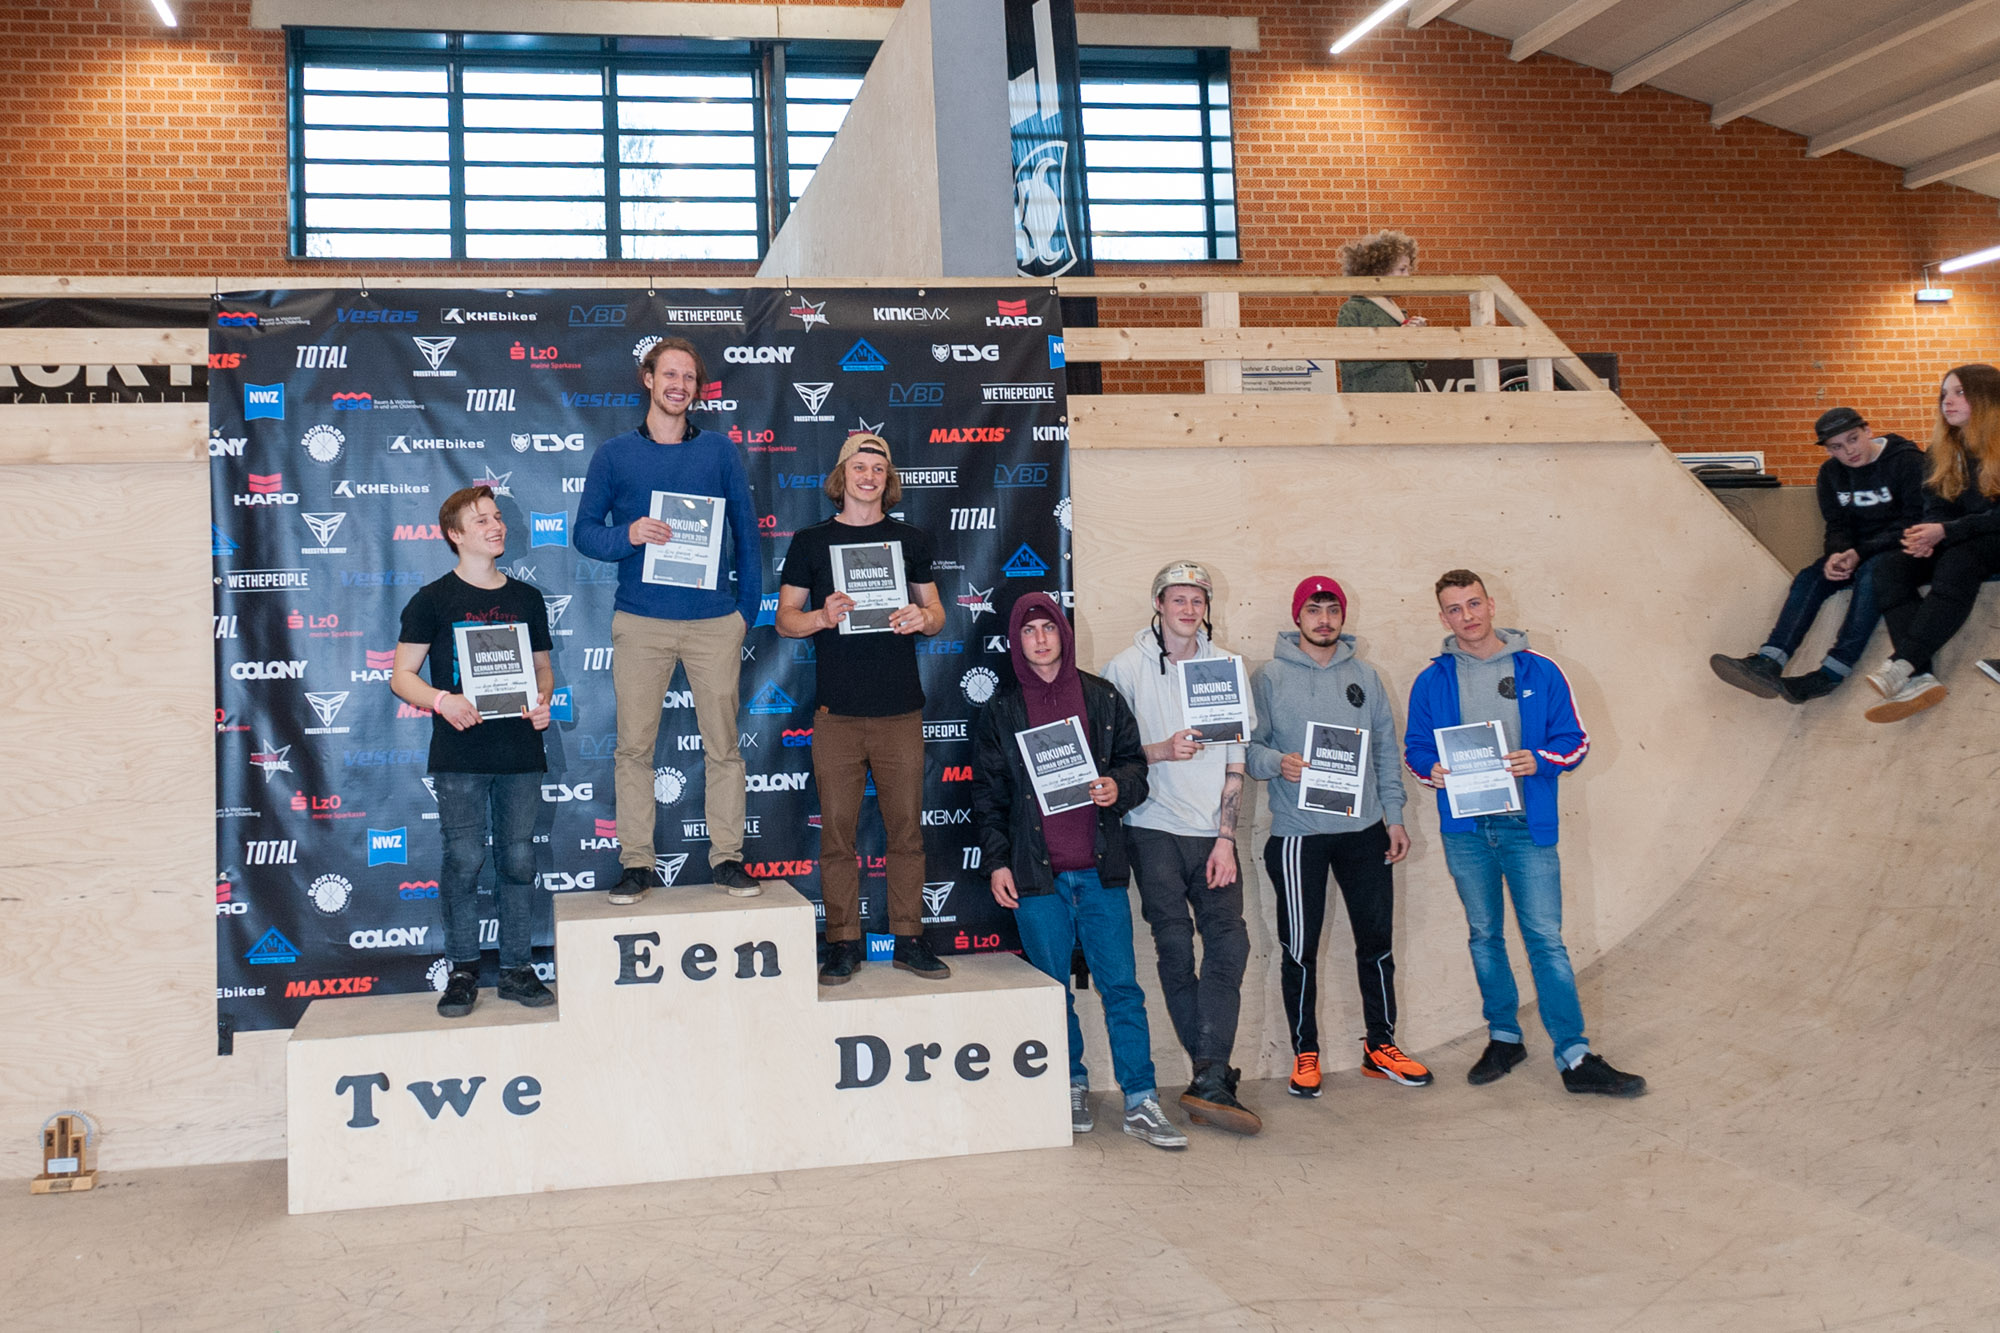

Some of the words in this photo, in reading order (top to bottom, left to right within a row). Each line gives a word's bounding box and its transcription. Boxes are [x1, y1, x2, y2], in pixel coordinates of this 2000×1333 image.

[336, 308, 419, 323] Vestas
[466, 312, 535, 321] KHEbikes
[667, 309, 743, 322] WETHEPEOPLE
[873, 307, 950, 320] KINKBMX
[986, 316, 1042, 327] HARO
[296, 346, 347, 368] TOTAL
[530, 346, 558, 360] LzO
[723, 346, 795, 364] COLONY
[208, 353, 241, 369] XIS
[249, 391, 279, 403] NWZ
[466, 389, 516, 411] TOTAL
[561, 392, 640, 407] Vestas
[982, 387, 1054, 400] WETHEPEOPLE
[332, 399, 372, 411] GSG
[301, 424, 345, 446] BACKYARD
[747, 429, 774, 443] LzO
[929, 427, 1005, 443] MAXXIS
[1033, 426, 1069, 441] KINK
[208, 438, 248, 456] ONY
[413, 439, 484, 449] KHEbikes
[895, 472, 957, 484] THEPEOPLE
[356, 484, 429, 493] KHEbikes
[234, 493, 299, 506] HARO
[535, 519, 563, 531] NWZ
[758, 514, 777, 528] zO
[950, 508, 996, 530] TOTAL
[393, 525, 442, 540] MAX
[228, 573, 308, 588] WETHEPEOPLE
[341, 571, 424, 586] Vestas
[849, 567, 889, 580] URKUNDE
[213, 615, 238, 638] TAL
[310, 615, 338, 627] LzO
[475, 650, 516, 663] URKUNDE
[583, 648, 613, 670] TOT
[230, 661, 308, 680] COLONY
[960, 667, 999, 689] BACKYARD
[1192, 681, 1233, 695] URKUNDE
[923, 724, 967, 737] EPEOPLE
[345, 751, 427, 766] Vestas
[1036, 743, 1076, 763] URKUNDE
[1316, 747, 1355, 763] URKUNDE
[1452, 746, 1495, 762] URKUNDE
[312, 796, 341, 809] LzO
[372, 836, 402, 849] NWZ
[246, 840, 297, 865] TOTAL
[307, 873, 352, 898] BACKYARD
[400, 888, 439, 900] GSG
[350, 927, 428, 949] COLONY
[974, 934, 1000, 948] LzO
[613, 931, 782, 985] Een
[285, 976, 374, 998] MAXXIS
[835, 1035, 1048, 1090] Dree
[336, 1072, 542, 1129] Twe
